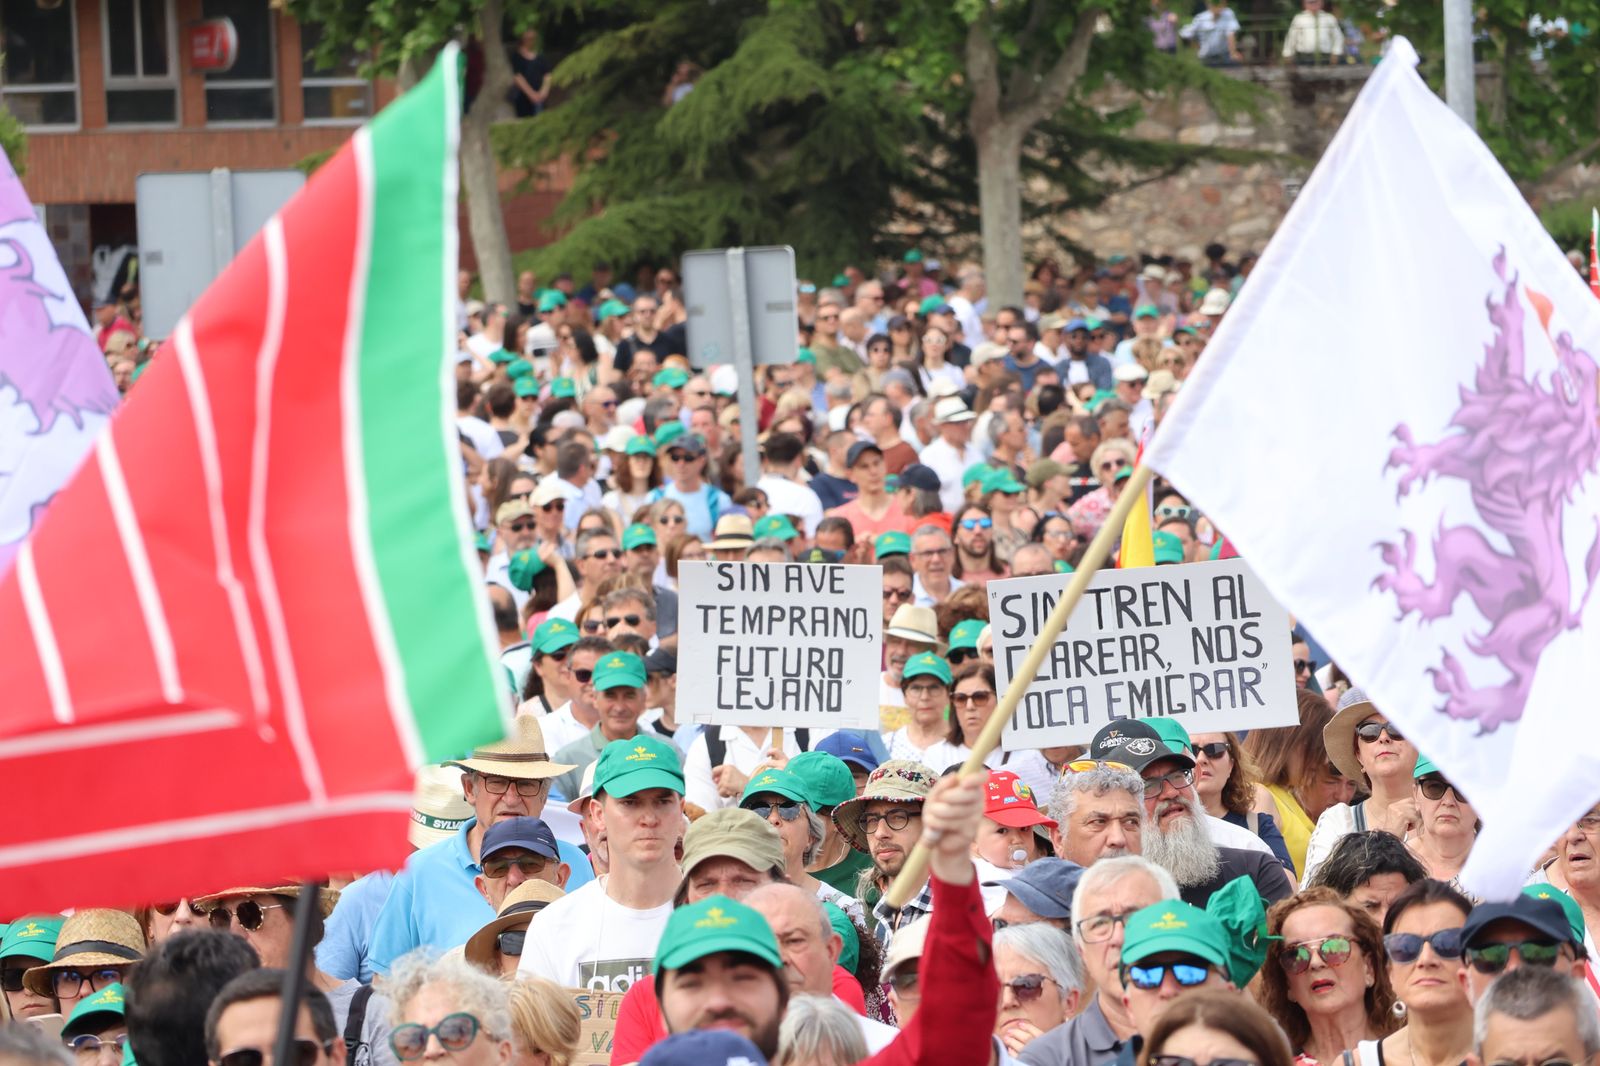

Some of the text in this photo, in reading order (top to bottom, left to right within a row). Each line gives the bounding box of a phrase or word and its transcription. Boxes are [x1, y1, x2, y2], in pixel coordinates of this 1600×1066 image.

[784, 564, 845, 594] AVE
[1084, 578, 1193, 631] TREN
[1212, 573, 1262, 621] AL
[696, 604, 873, 643] TEMPRANO,
[717, 645, 844, 679] FUTURO
[1191, 621, 1263, 666] NOS
